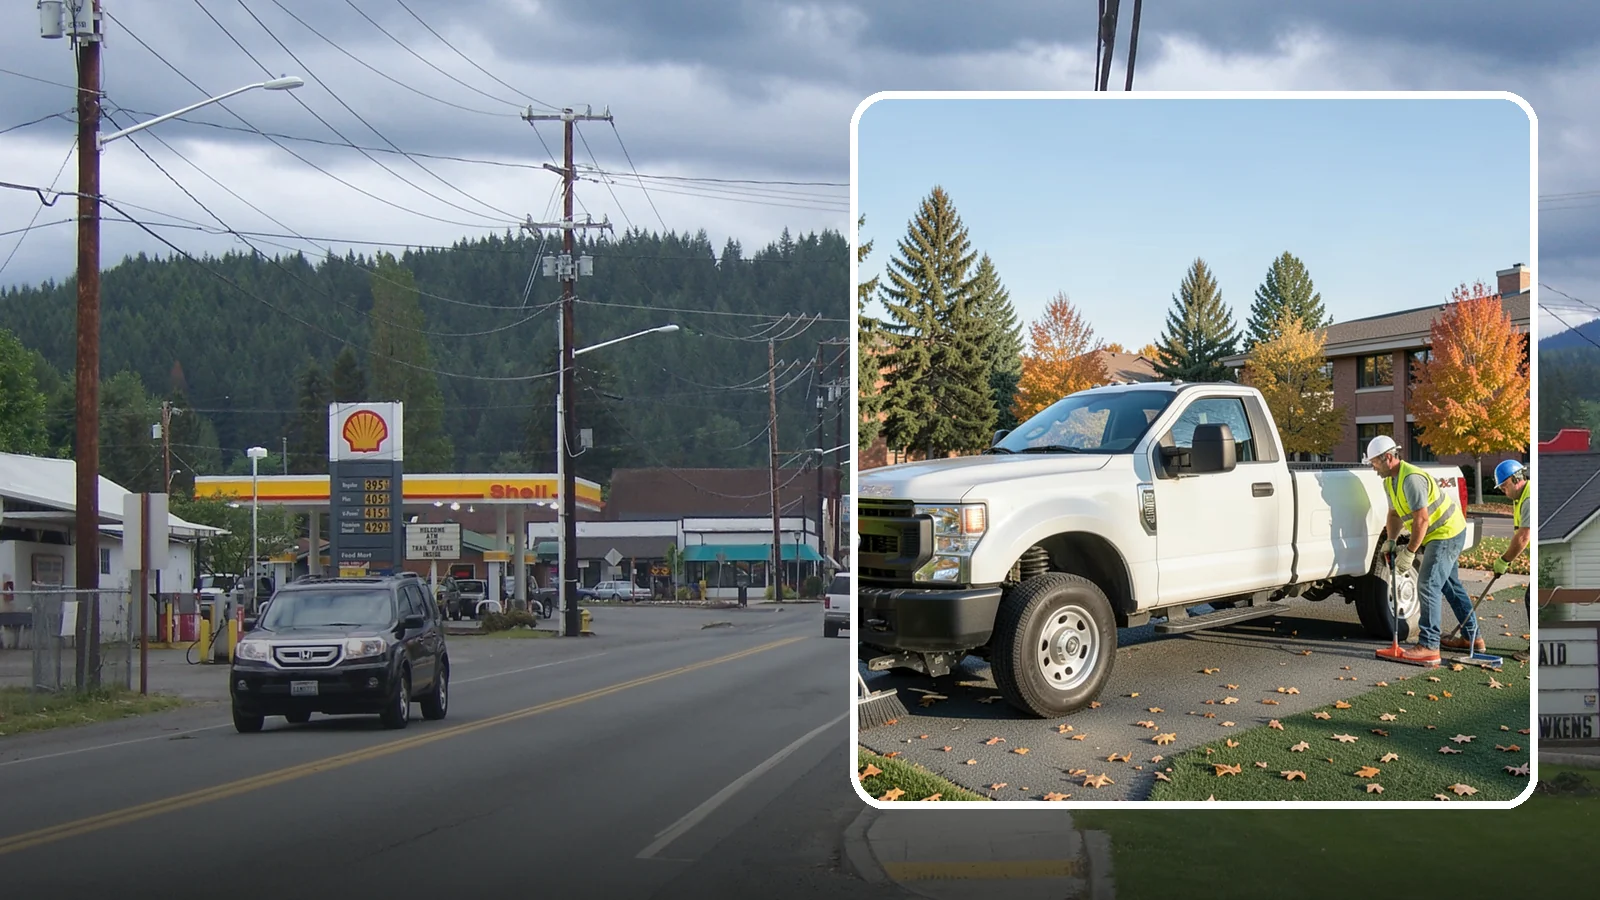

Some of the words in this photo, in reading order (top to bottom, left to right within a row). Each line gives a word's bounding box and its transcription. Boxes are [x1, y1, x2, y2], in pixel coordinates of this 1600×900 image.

[366, 480, 383, 490] 395
[490, 484, 547, 499] Shell
[366, 494, 383, 504] 405
[366, 508, 383, 518] 415
[366, 522, 383, 532] 429
